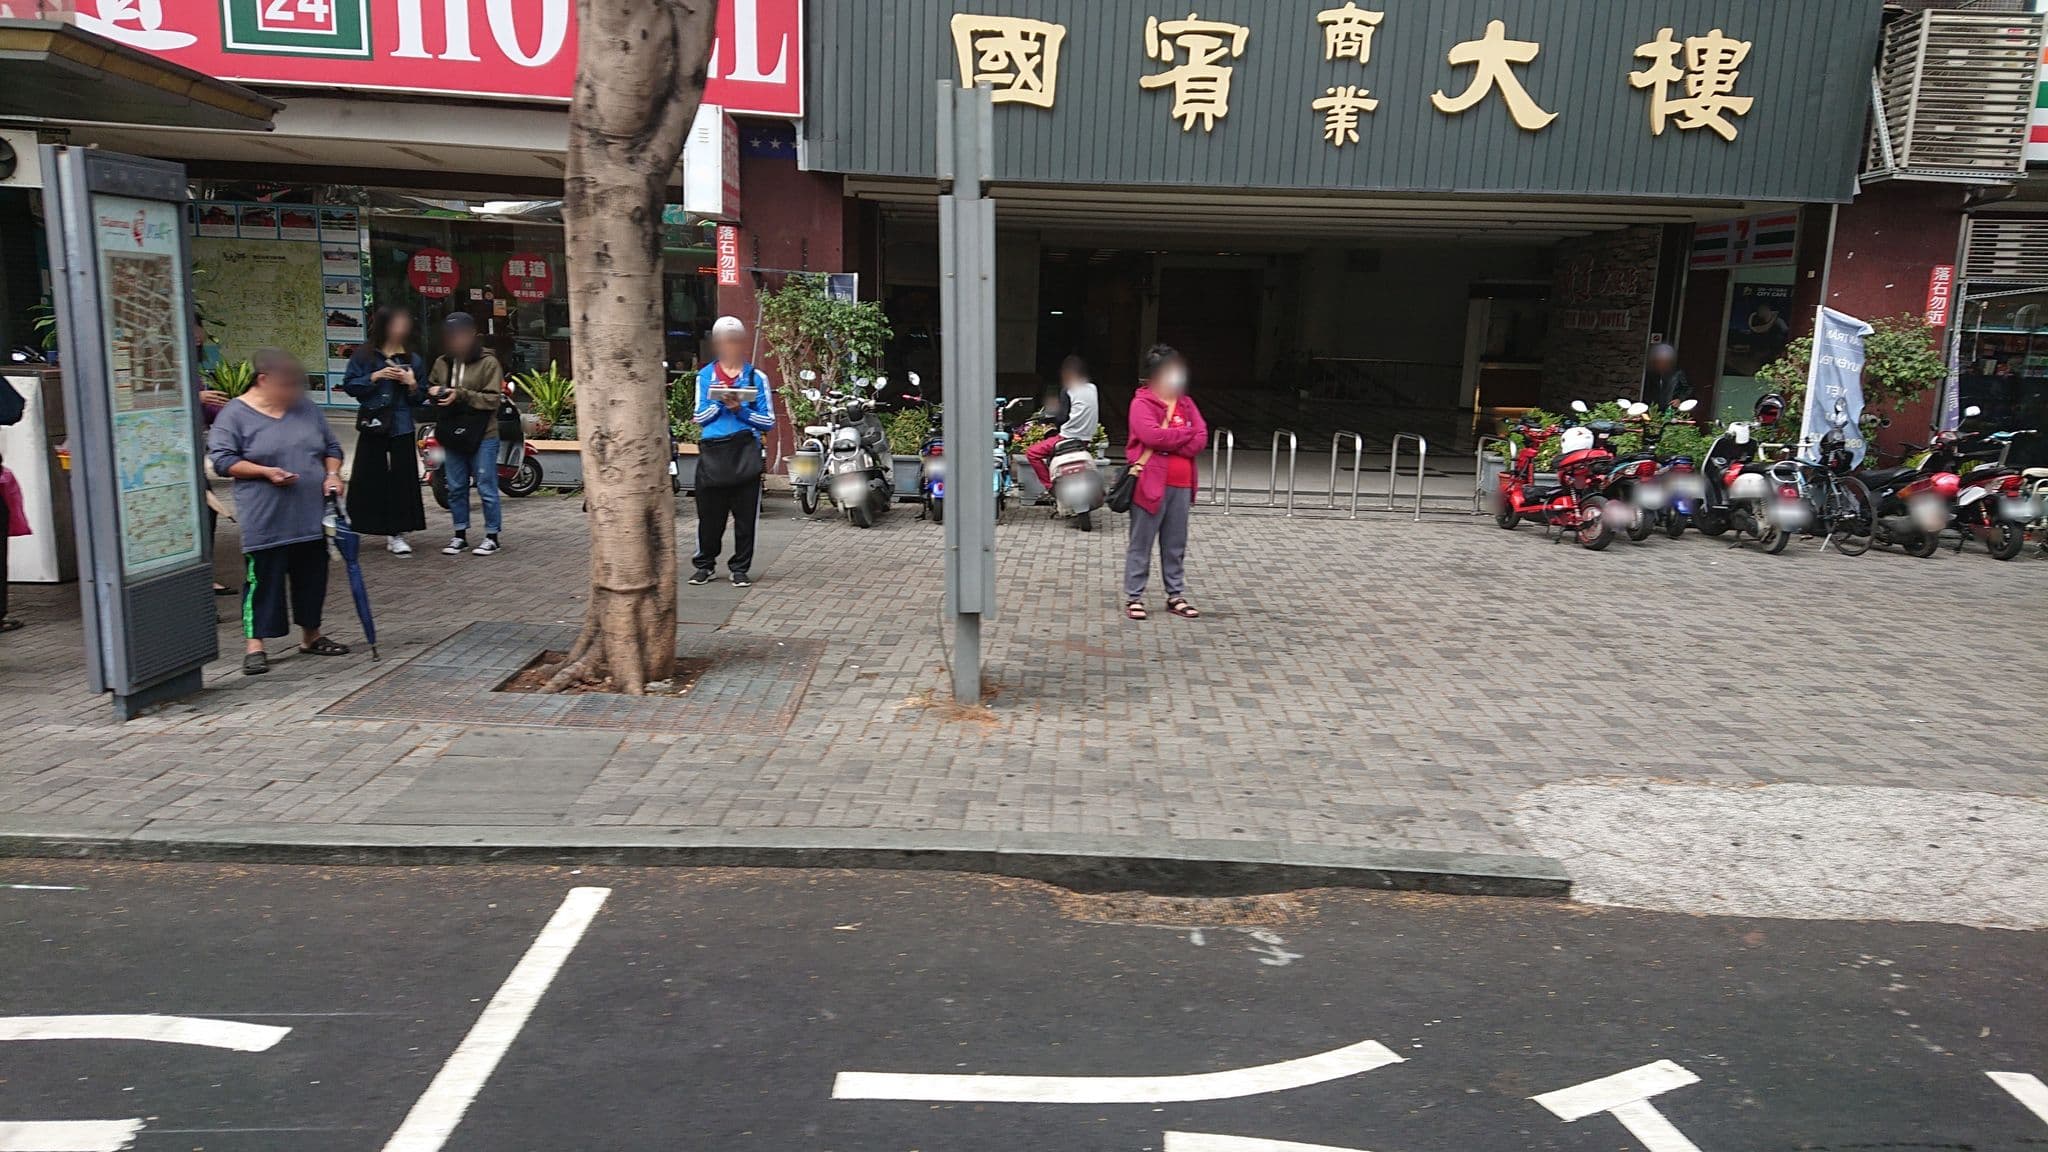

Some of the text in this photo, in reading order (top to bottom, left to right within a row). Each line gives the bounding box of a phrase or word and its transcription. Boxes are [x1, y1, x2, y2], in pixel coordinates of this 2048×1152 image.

[719, 226, 737, 284] 落石勿近
[1927, 266, 1952, 325] 落石勿近
